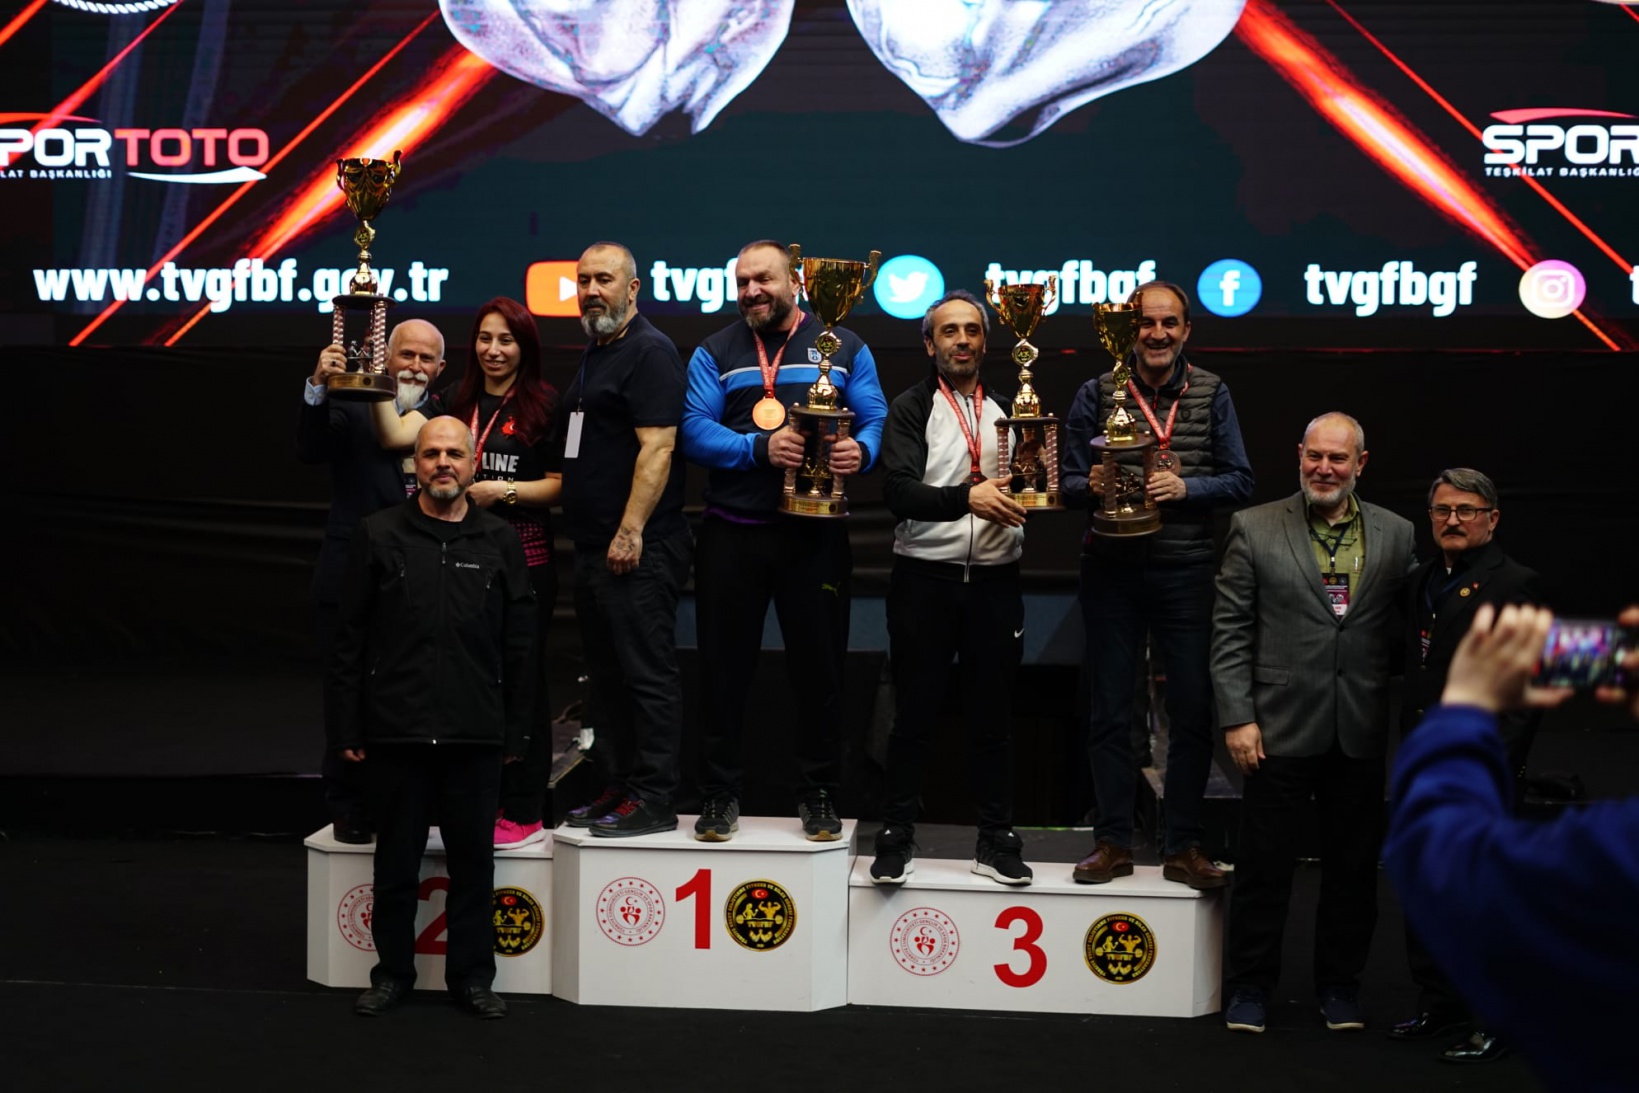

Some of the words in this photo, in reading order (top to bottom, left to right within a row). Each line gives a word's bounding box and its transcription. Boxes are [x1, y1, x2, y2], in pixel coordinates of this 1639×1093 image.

[114, 128, 269, 167] TOTO
[1482, 124, 1639, 165] SPOR
[29, 168, 112, 180] BAŞKANLIĞI
[1484, 166, 1554, 178] TEŞKİLAT
[650, 257, 809, 313] tvgf
[1304, 260, 1478, 317] tvgfbgf
[482, 452, 519, 473] LINE
[415, 876, 450, 955] 2
[675, 868, 712, 950] 1
[993, 906, 1048, 988] 3
